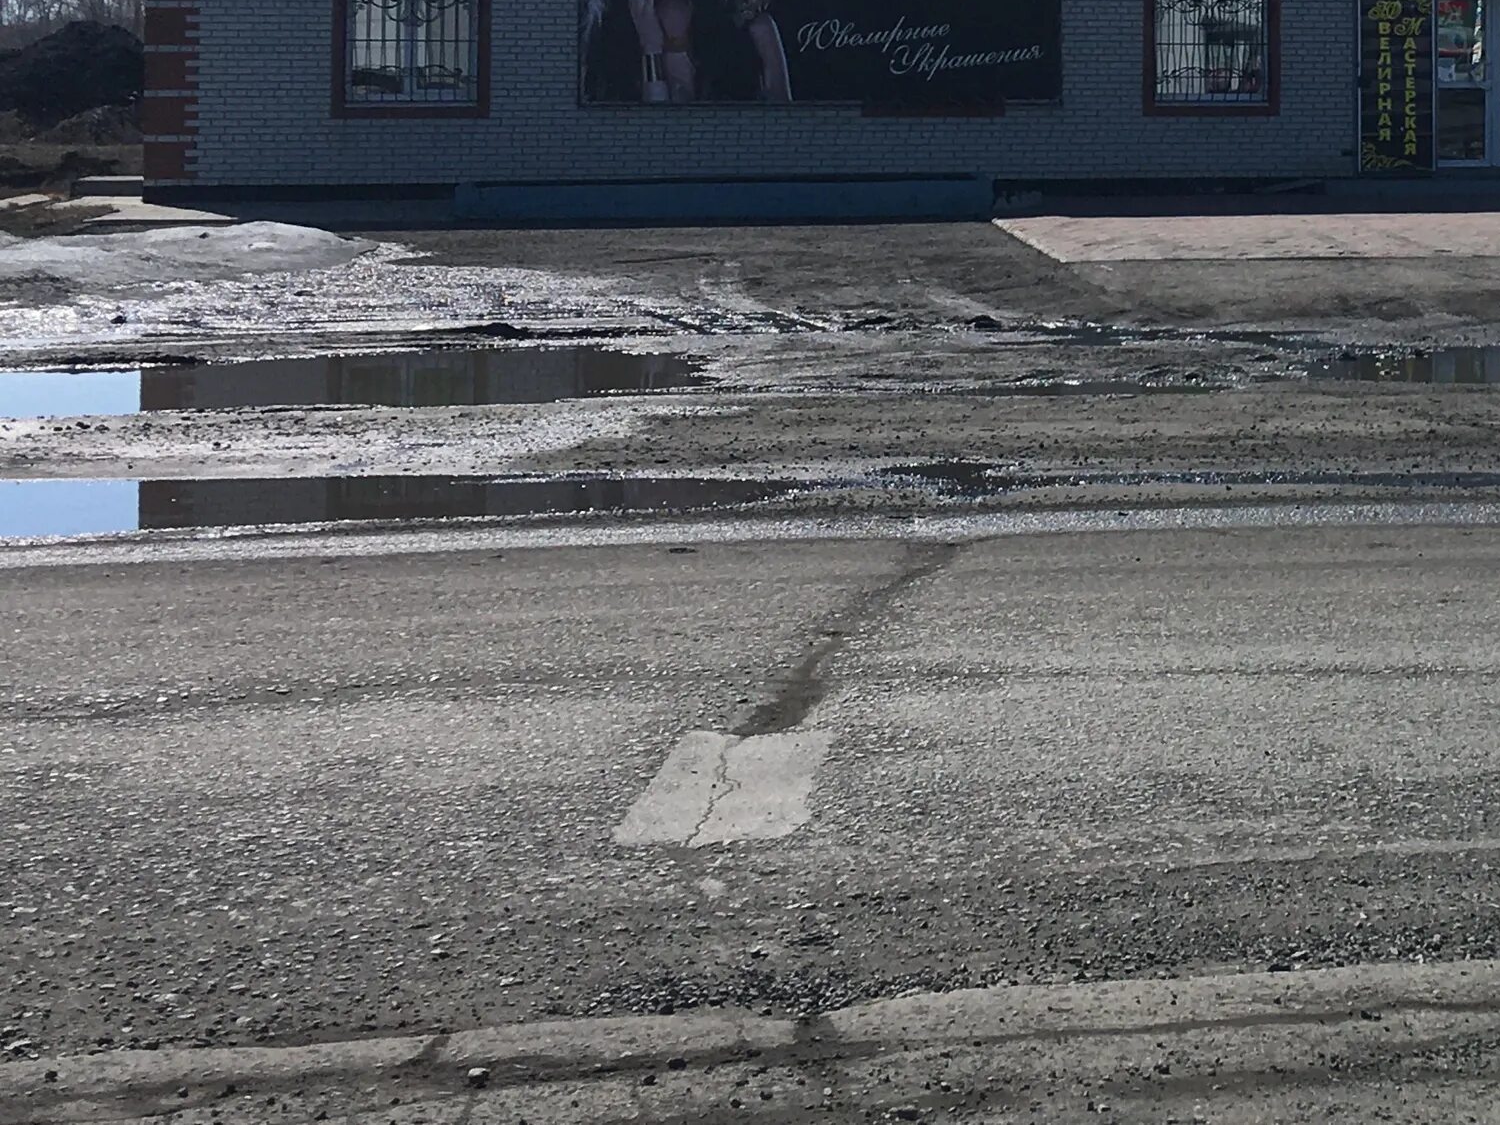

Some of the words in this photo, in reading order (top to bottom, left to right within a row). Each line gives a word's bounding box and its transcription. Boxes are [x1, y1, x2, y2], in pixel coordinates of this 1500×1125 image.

[797, 15, 952, 53] Ювелирные
[889, 42, 1045, 82] Украшения
[1368, 0, 1402, 142] ЮВЕЛИРНАЯ
[1394, 18, 1425, 156] МАСТЕРСКАЯ
